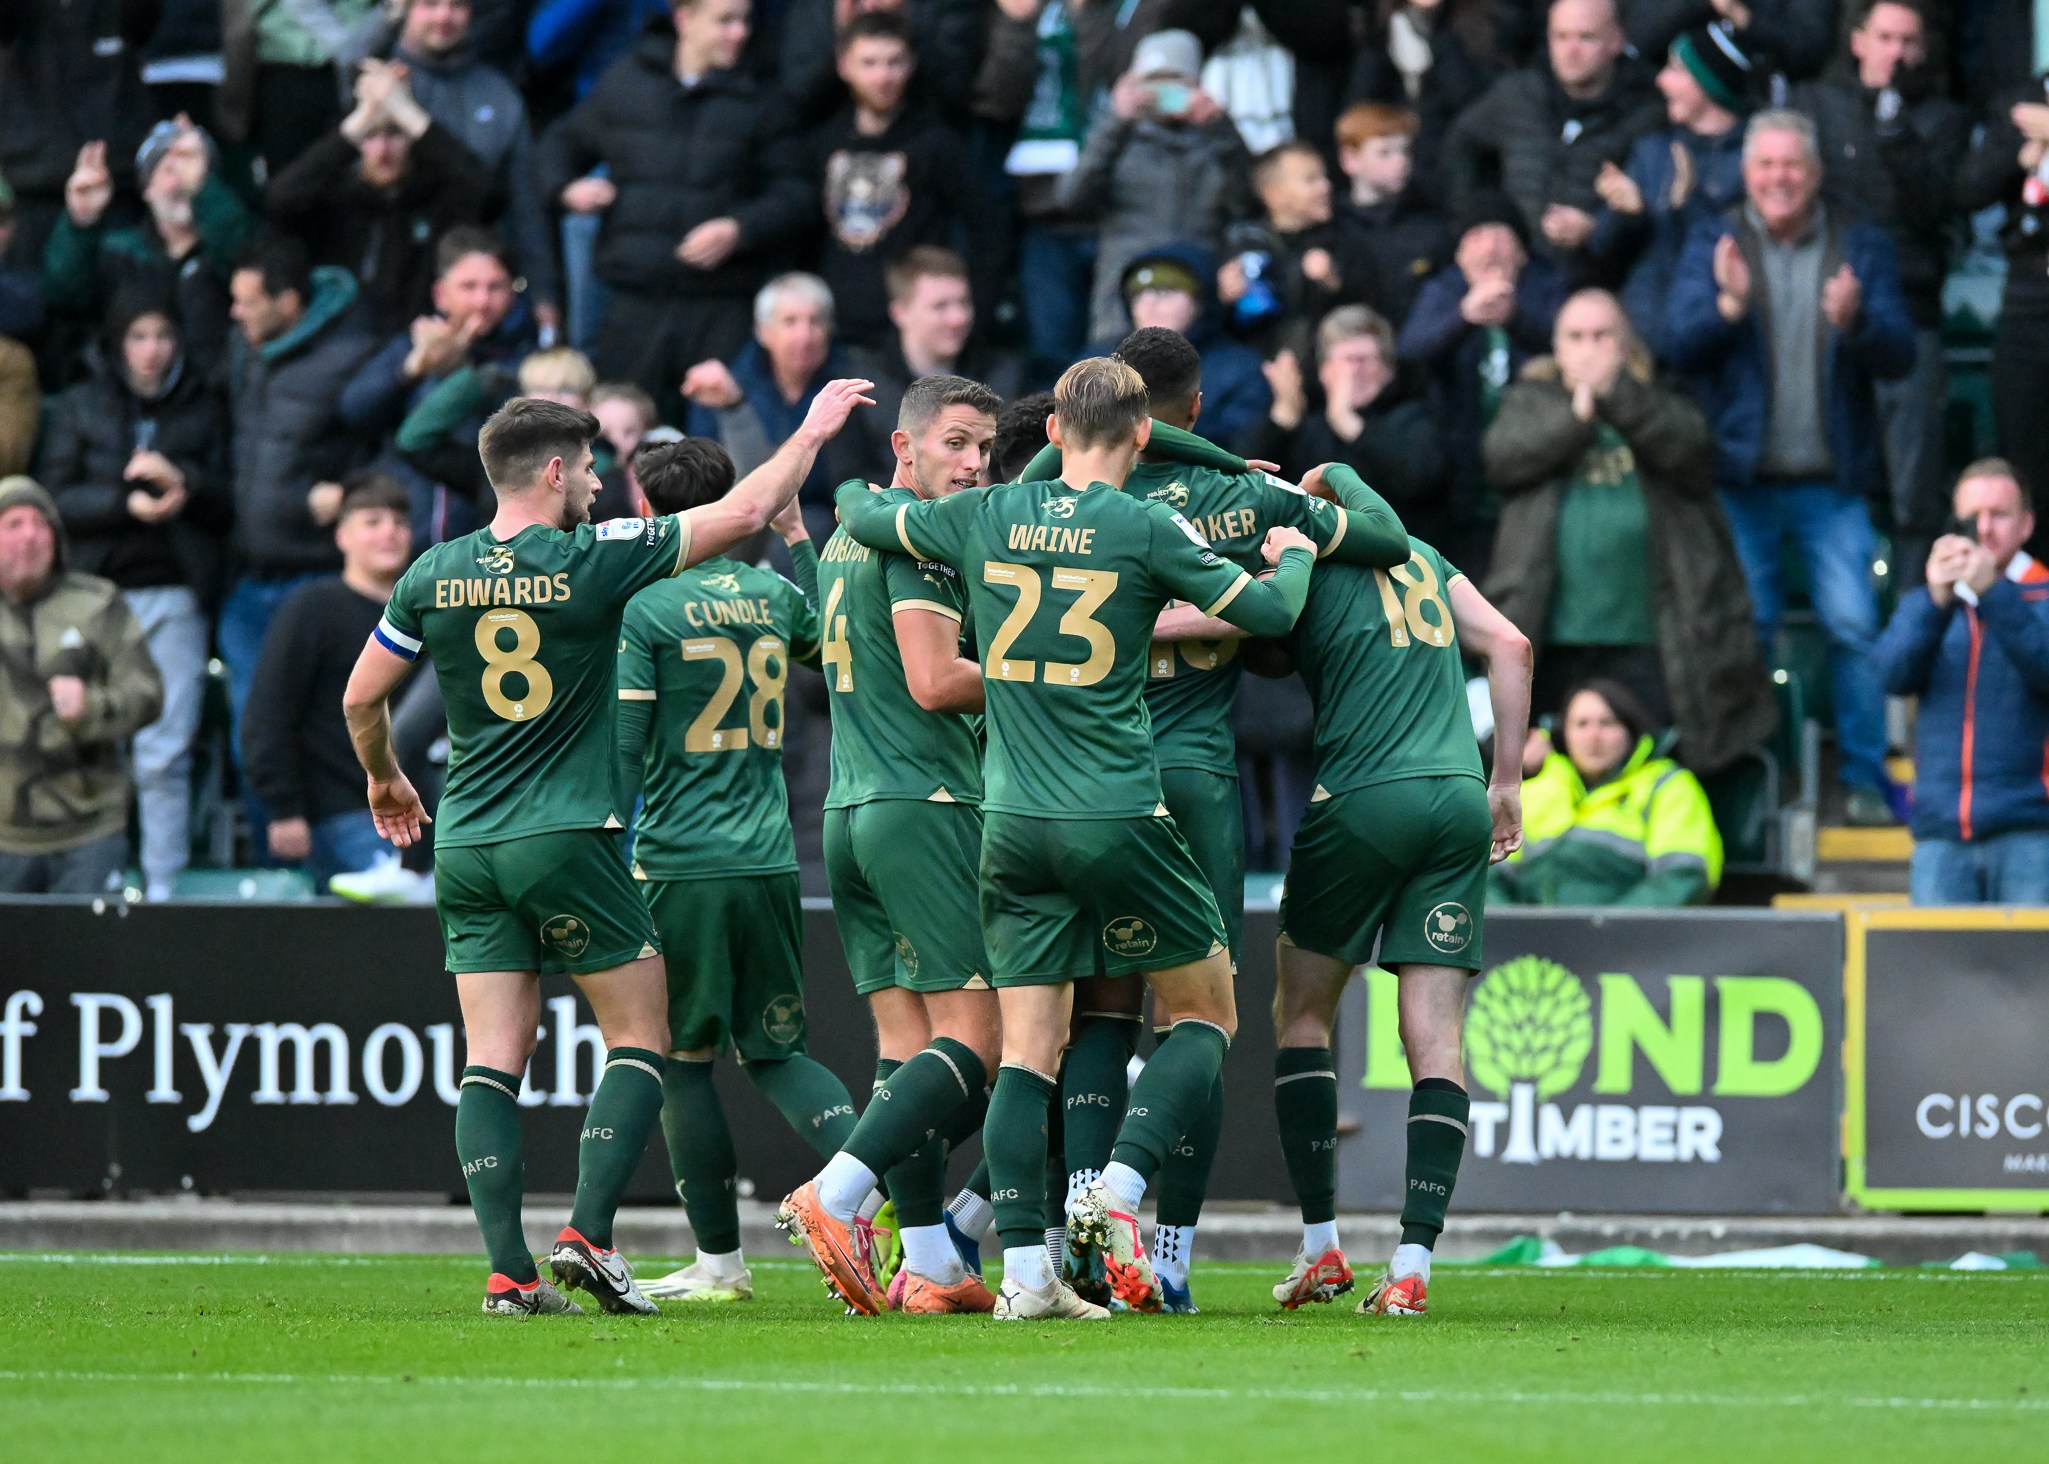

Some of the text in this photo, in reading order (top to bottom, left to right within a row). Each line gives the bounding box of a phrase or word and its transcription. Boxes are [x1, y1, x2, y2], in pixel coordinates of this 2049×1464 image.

[1008, 523, 1096, 555] WAINE
[917, 561, 956, 579] TOGETHER
[435, 572, 571, 609] EDWARDS
[1372, 549, 1455, 647] 18
[685, 598, 774, 627] CUNDLE
[983, 560, 1119, 687] 23
[821, 576, 854, 692] 4
[474, 607, 554, 722] 8
[681, 634, 788, 752] 28
[1115, 938, 1150, 951] retain
[1431, 931, 1464, 945] retain
[1067, 1093, 1111, 1111] PAFC
[1916, 1092, 2049, 1140] CISC
[580, 1127, 614, 1143] AFC
[990, 1188, 1019, 1202] AFC
[1410, 1178, 1447, 1197] PAFC
